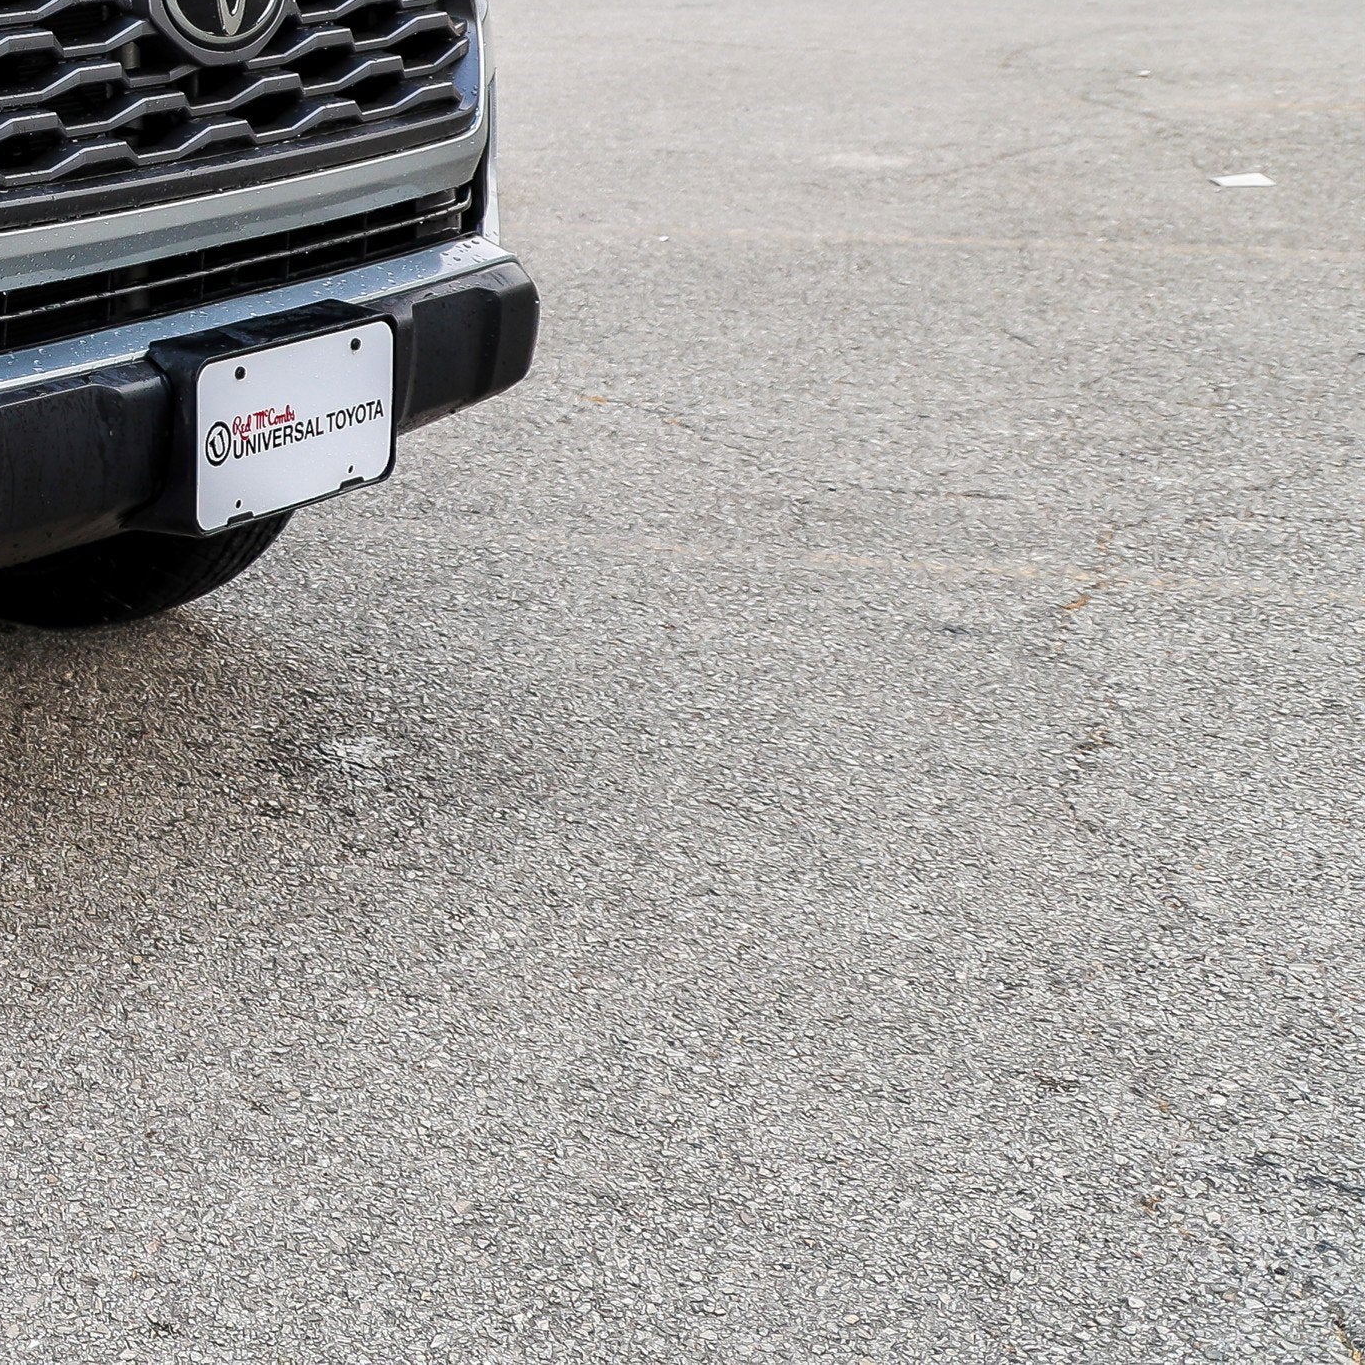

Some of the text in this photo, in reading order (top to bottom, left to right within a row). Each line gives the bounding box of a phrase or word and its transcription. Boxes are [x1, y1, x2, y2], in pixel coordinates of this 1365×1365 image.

[232, 414, 252, 441] Red
[233, 399, 384, 459] UNIVERSAL TOYOTA
